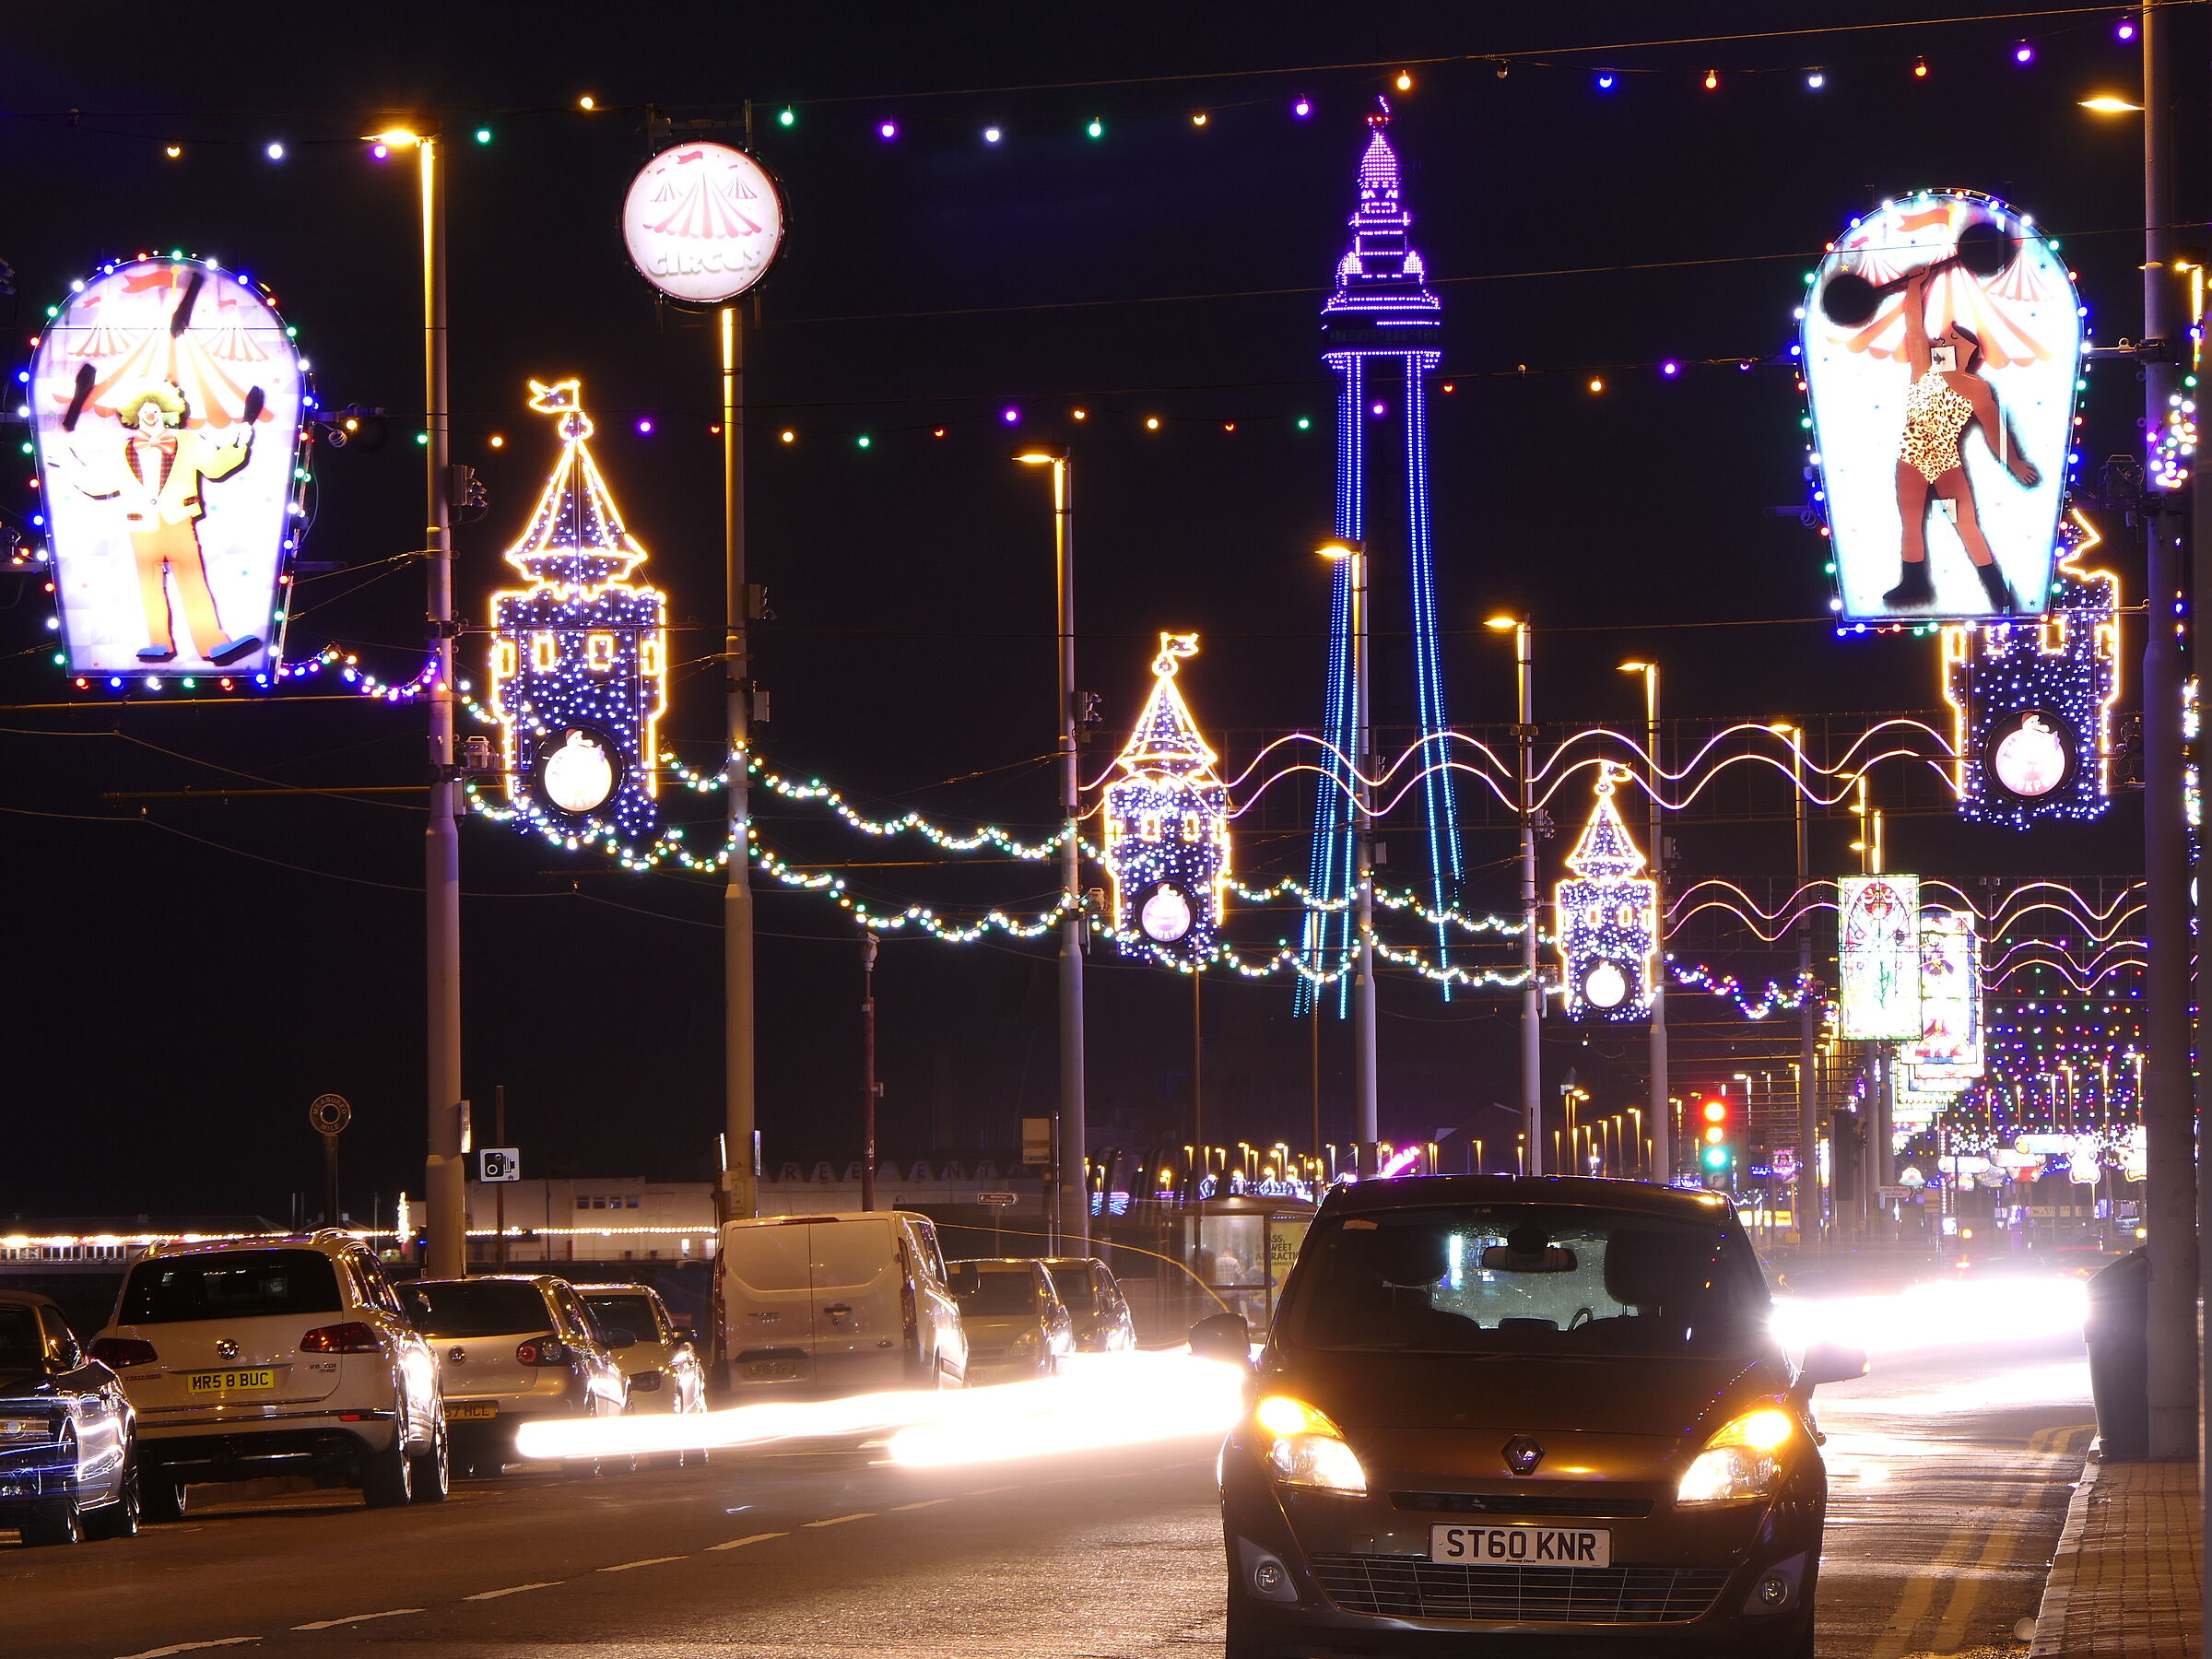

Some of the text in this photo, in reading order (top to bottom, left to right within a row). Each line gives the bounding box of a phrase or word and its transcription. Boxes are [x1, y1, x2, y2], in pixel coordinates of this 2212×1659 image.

[313, 1097, 347, 1114] MEASURED
[322, 1124, 340, 1132] MILE
[785, 1162, 861, 1181] REE
[240, 1371, 269, 1386] BUC
[1446, 1529, 1596, 1561] ST60 KNR
